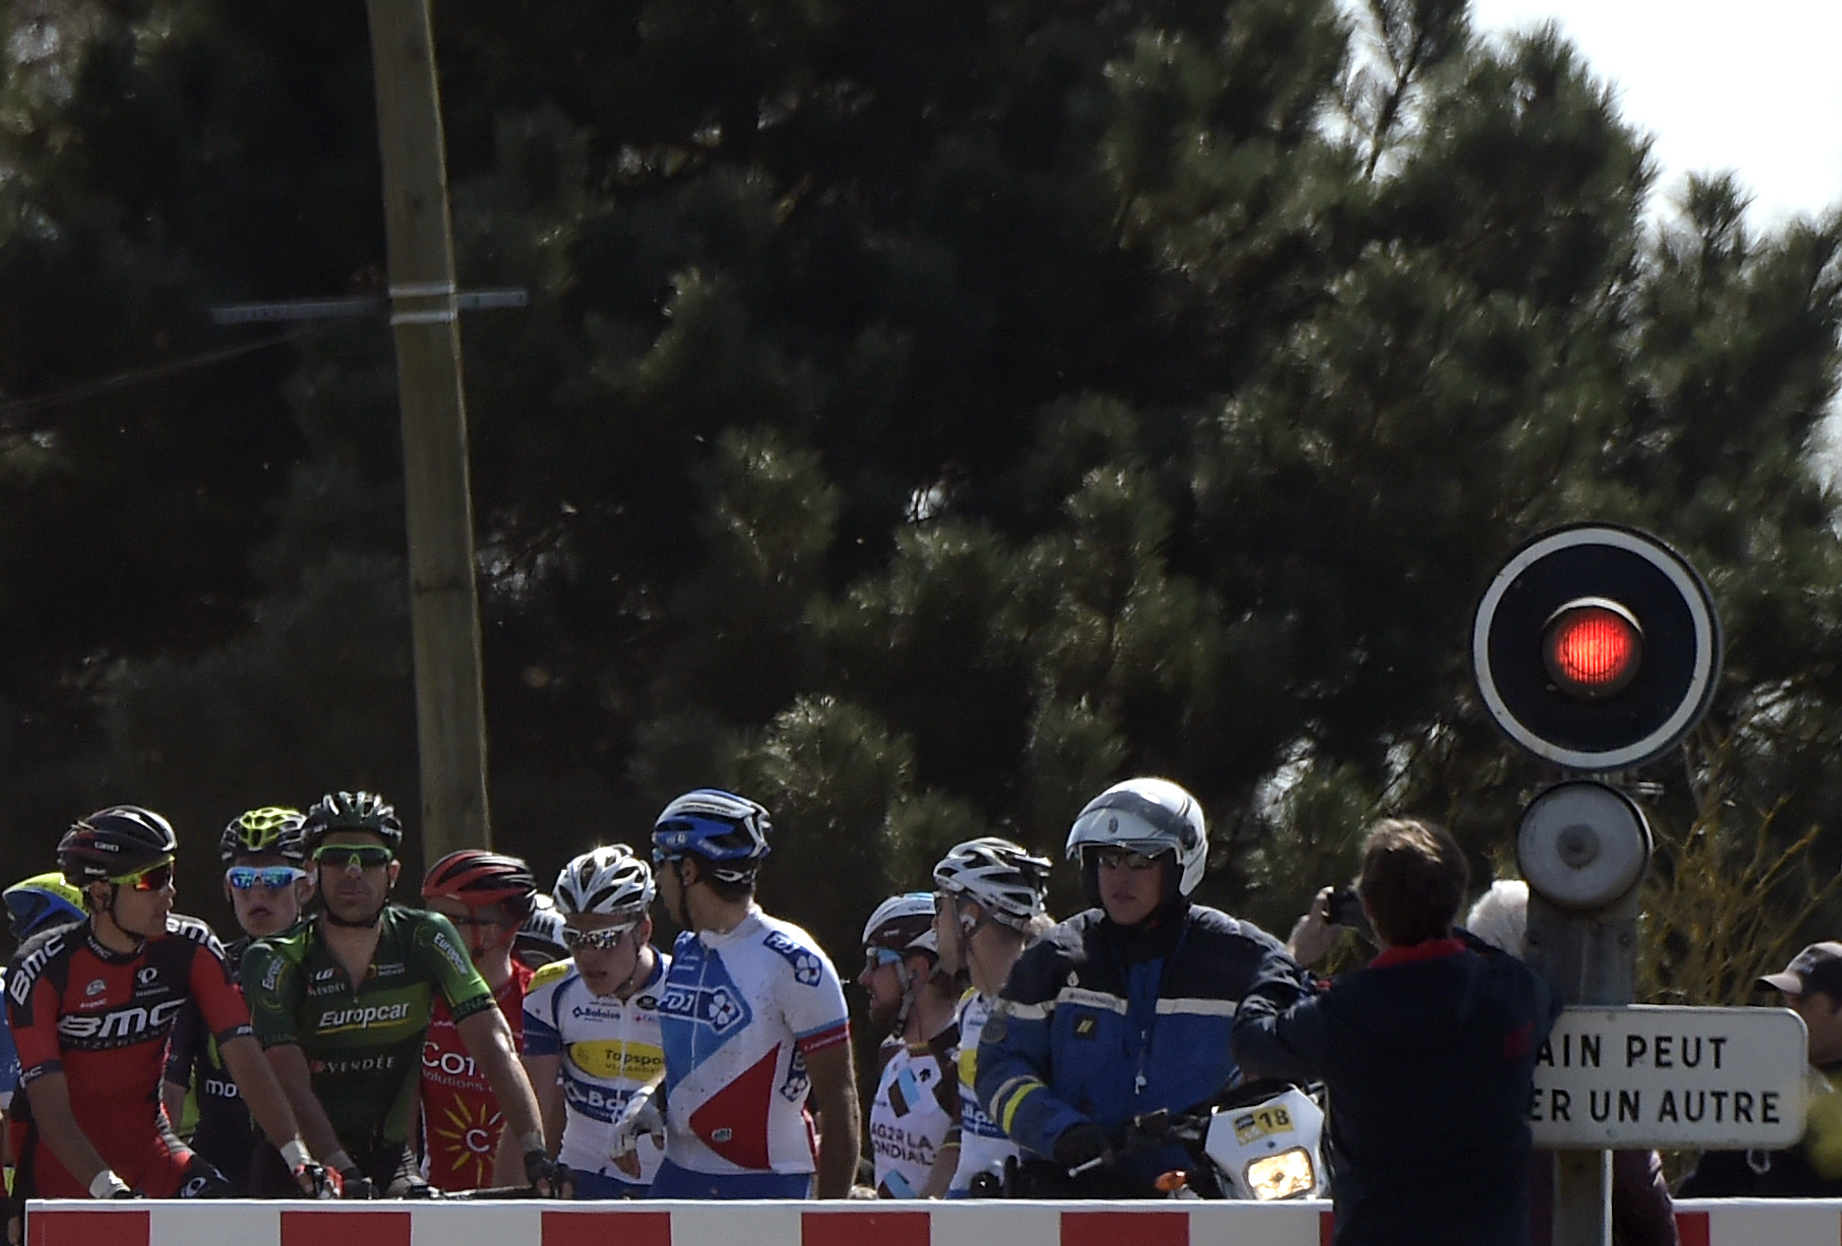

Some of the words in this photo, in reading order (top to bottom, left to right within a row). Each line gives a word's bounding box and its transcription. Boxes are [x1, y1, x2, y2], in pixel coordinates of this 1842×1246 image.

[9, 933, 65, 1006] BMC
[57, 998, 187, 1038] BMC
[319, 1002, 410, 1029] Europcar
[655, 991, 695, 1012] FDJ
[1535, 1034, 1601, 1067] AIN
[1626, 1035, 1727, 1068] PEUT
[1259, 1109, 1290, 1128] 18
[1530, 1089, 1571, 1121] ER
[1589, 1090, 1640, 1122] UN
[1658, 1090, 1780, 1123] AUTRE
